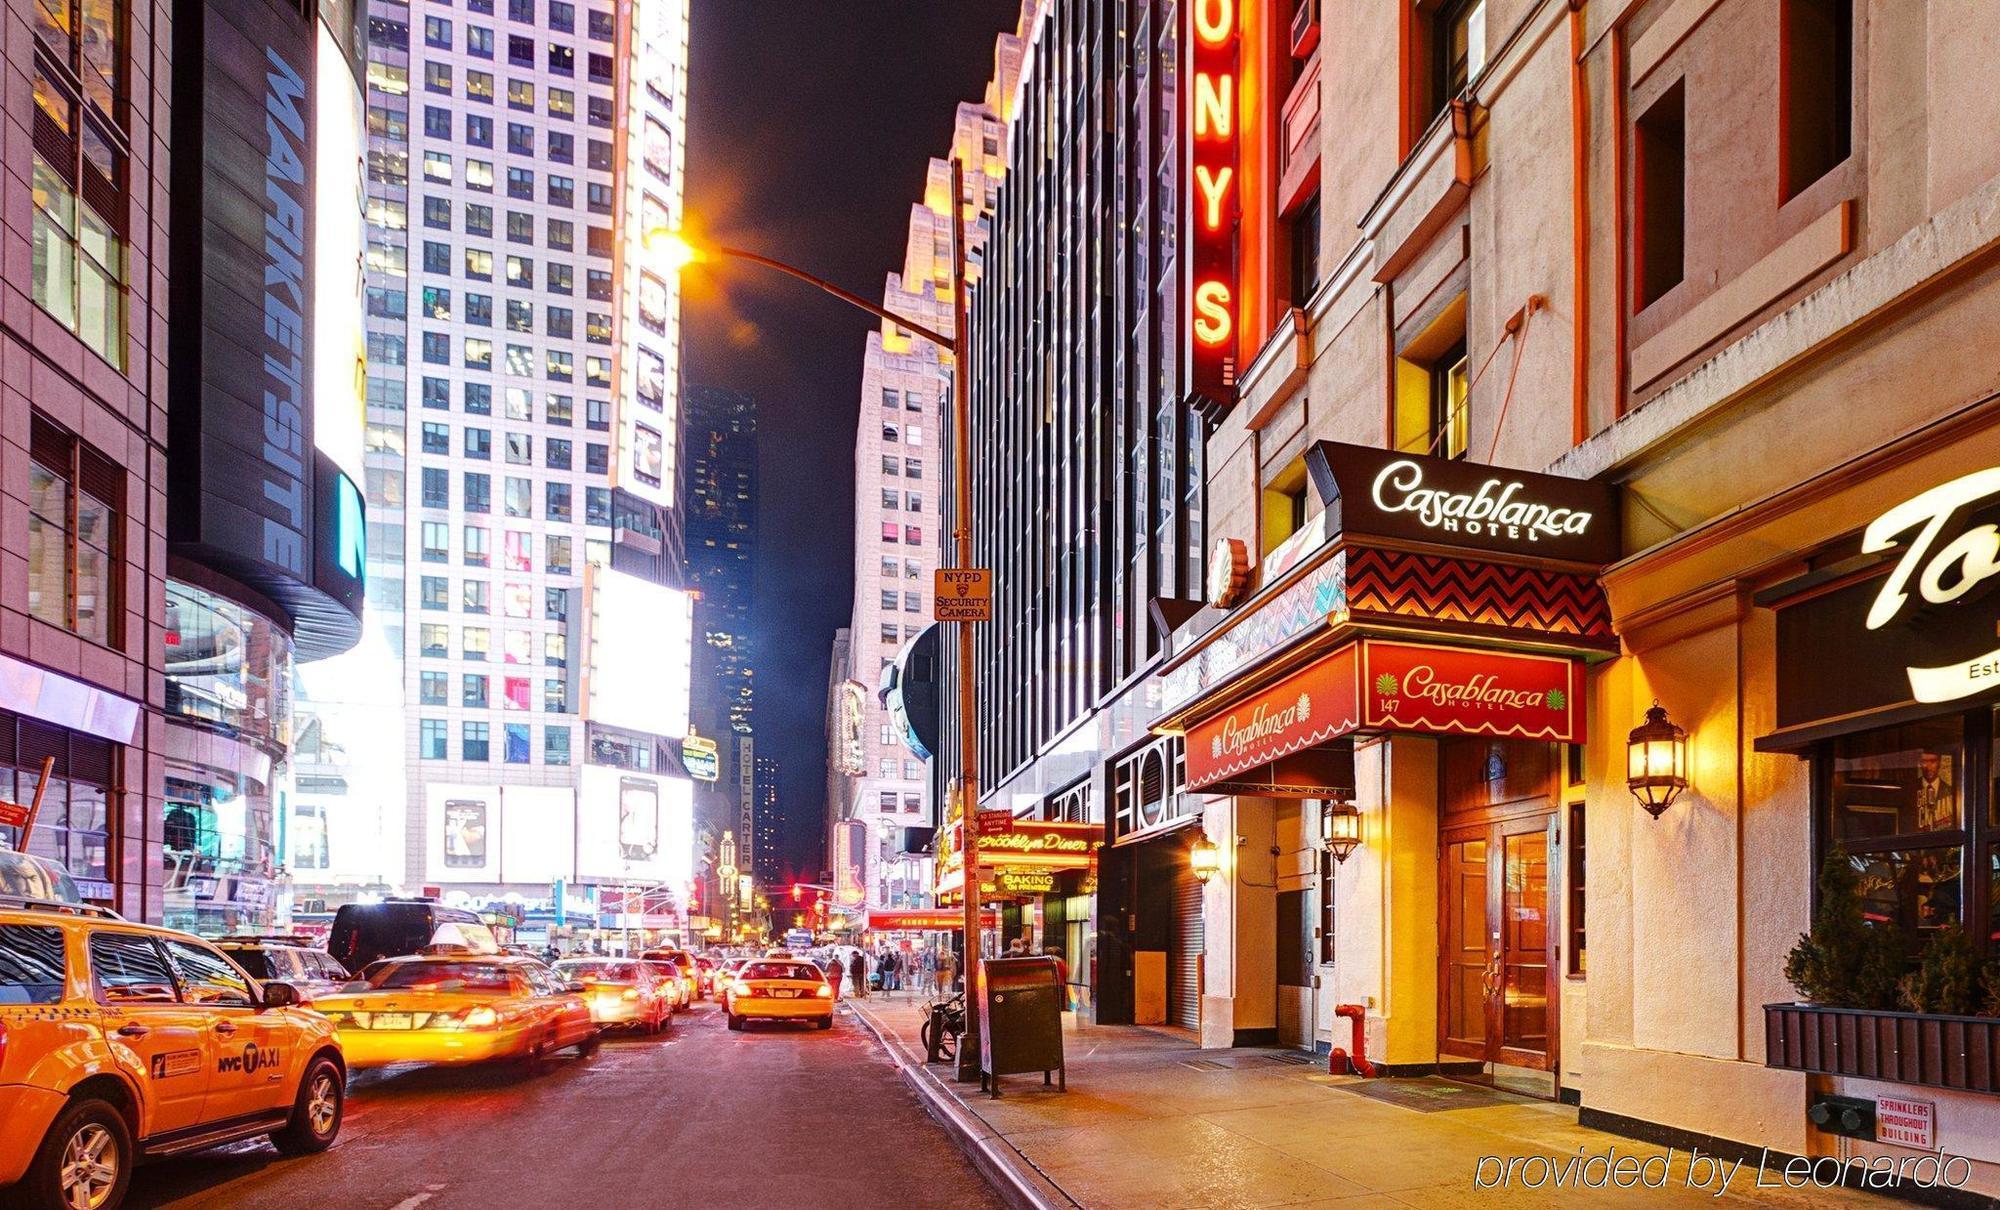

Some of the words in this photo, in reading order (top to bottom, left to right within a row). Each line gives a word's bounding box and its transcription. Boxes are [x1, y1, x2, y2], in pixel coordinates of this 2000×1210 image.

[264, 46, 306, 575] MARKETSITE
[1372, 460, 1592, 536] Casablanca
[1443, 517, 1539, 542] HOTEL
[944, 573, 981, 582] NYPD
[936, 596, 988, 607] SECURITY
[938, 607, 985, 617] CAMERA
[1402, 665, 1543, 709] Casablanca
[1379, 699, 1399, 712] 147
[1448, 699, 1505, 711] HOTEL
[1222, 703, 1296, 756] Casablanca
[1243, 736, 1273, 753] HOTEL
[742, 743, 751, 795] HOTEL
[742, 802, 751, 864] CARTER
[1044, 834, 1087, 851] Diner
[1003, 874, 1054, 885] BAKING
[218, 1057, 242, 1073] NYC
[1880, 1099, 1928, 1117] SPRINKLERS
[1880, 1113, 1928, 1130] THROUGHOUT
[1881, 1127, 1927, 1144] BUILDING
